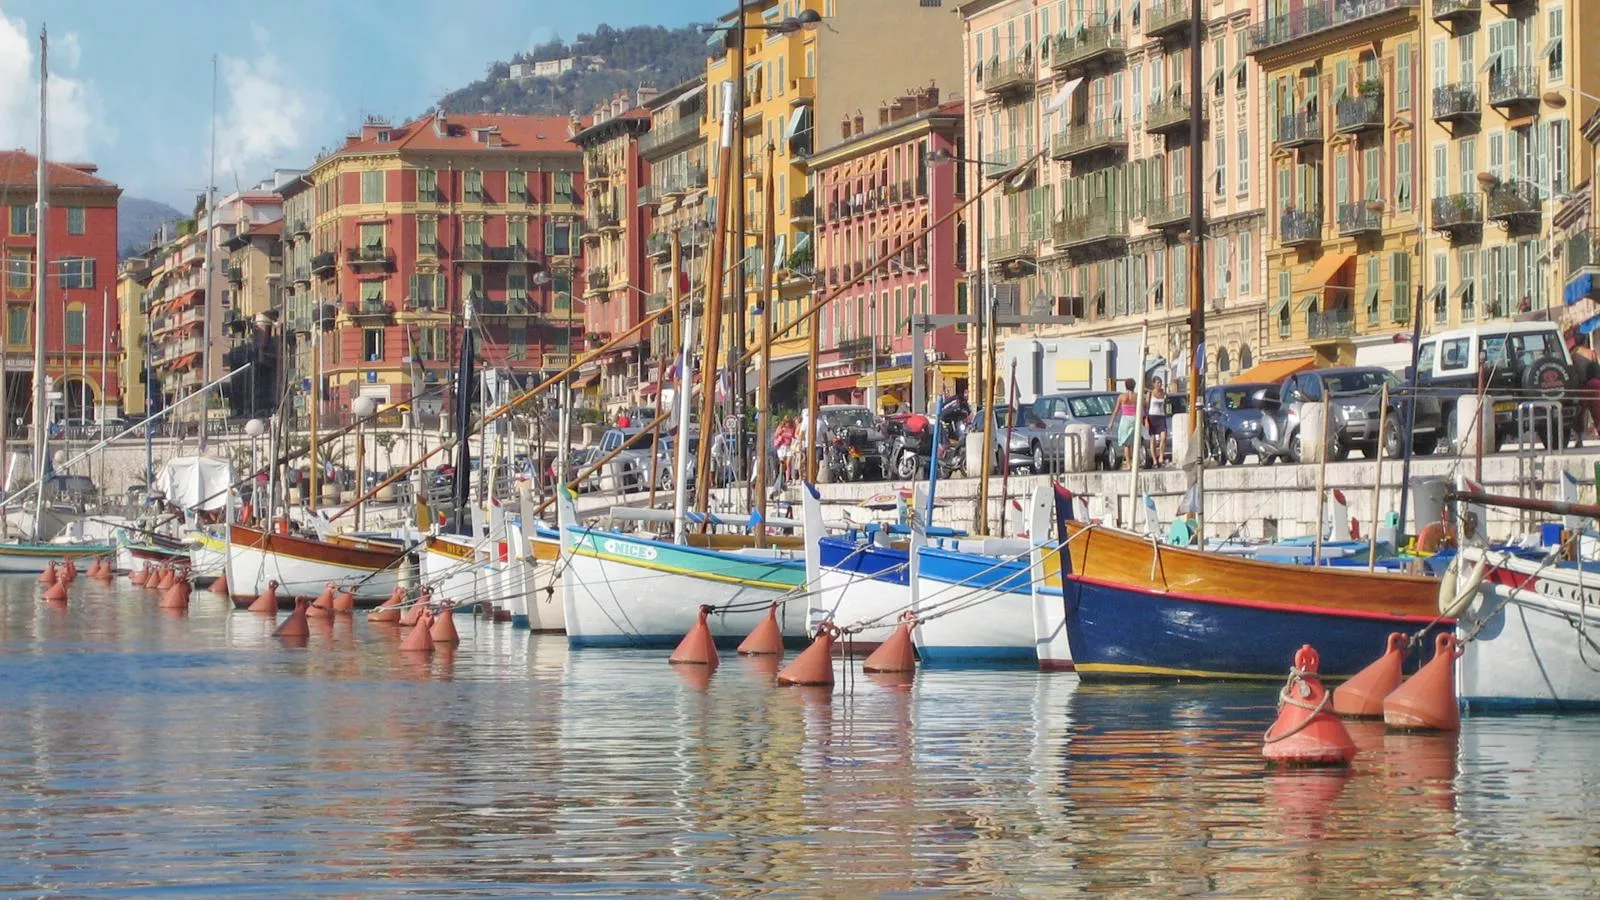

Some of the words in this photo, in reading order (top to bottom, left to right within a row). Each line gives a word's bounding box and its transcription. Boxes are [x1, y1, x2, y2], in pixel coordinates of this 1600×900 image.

[615, 541, 646, 558] NICE
[1544, 582, 1564, 598] LA
[1571, 589, 1600, 606] GA
